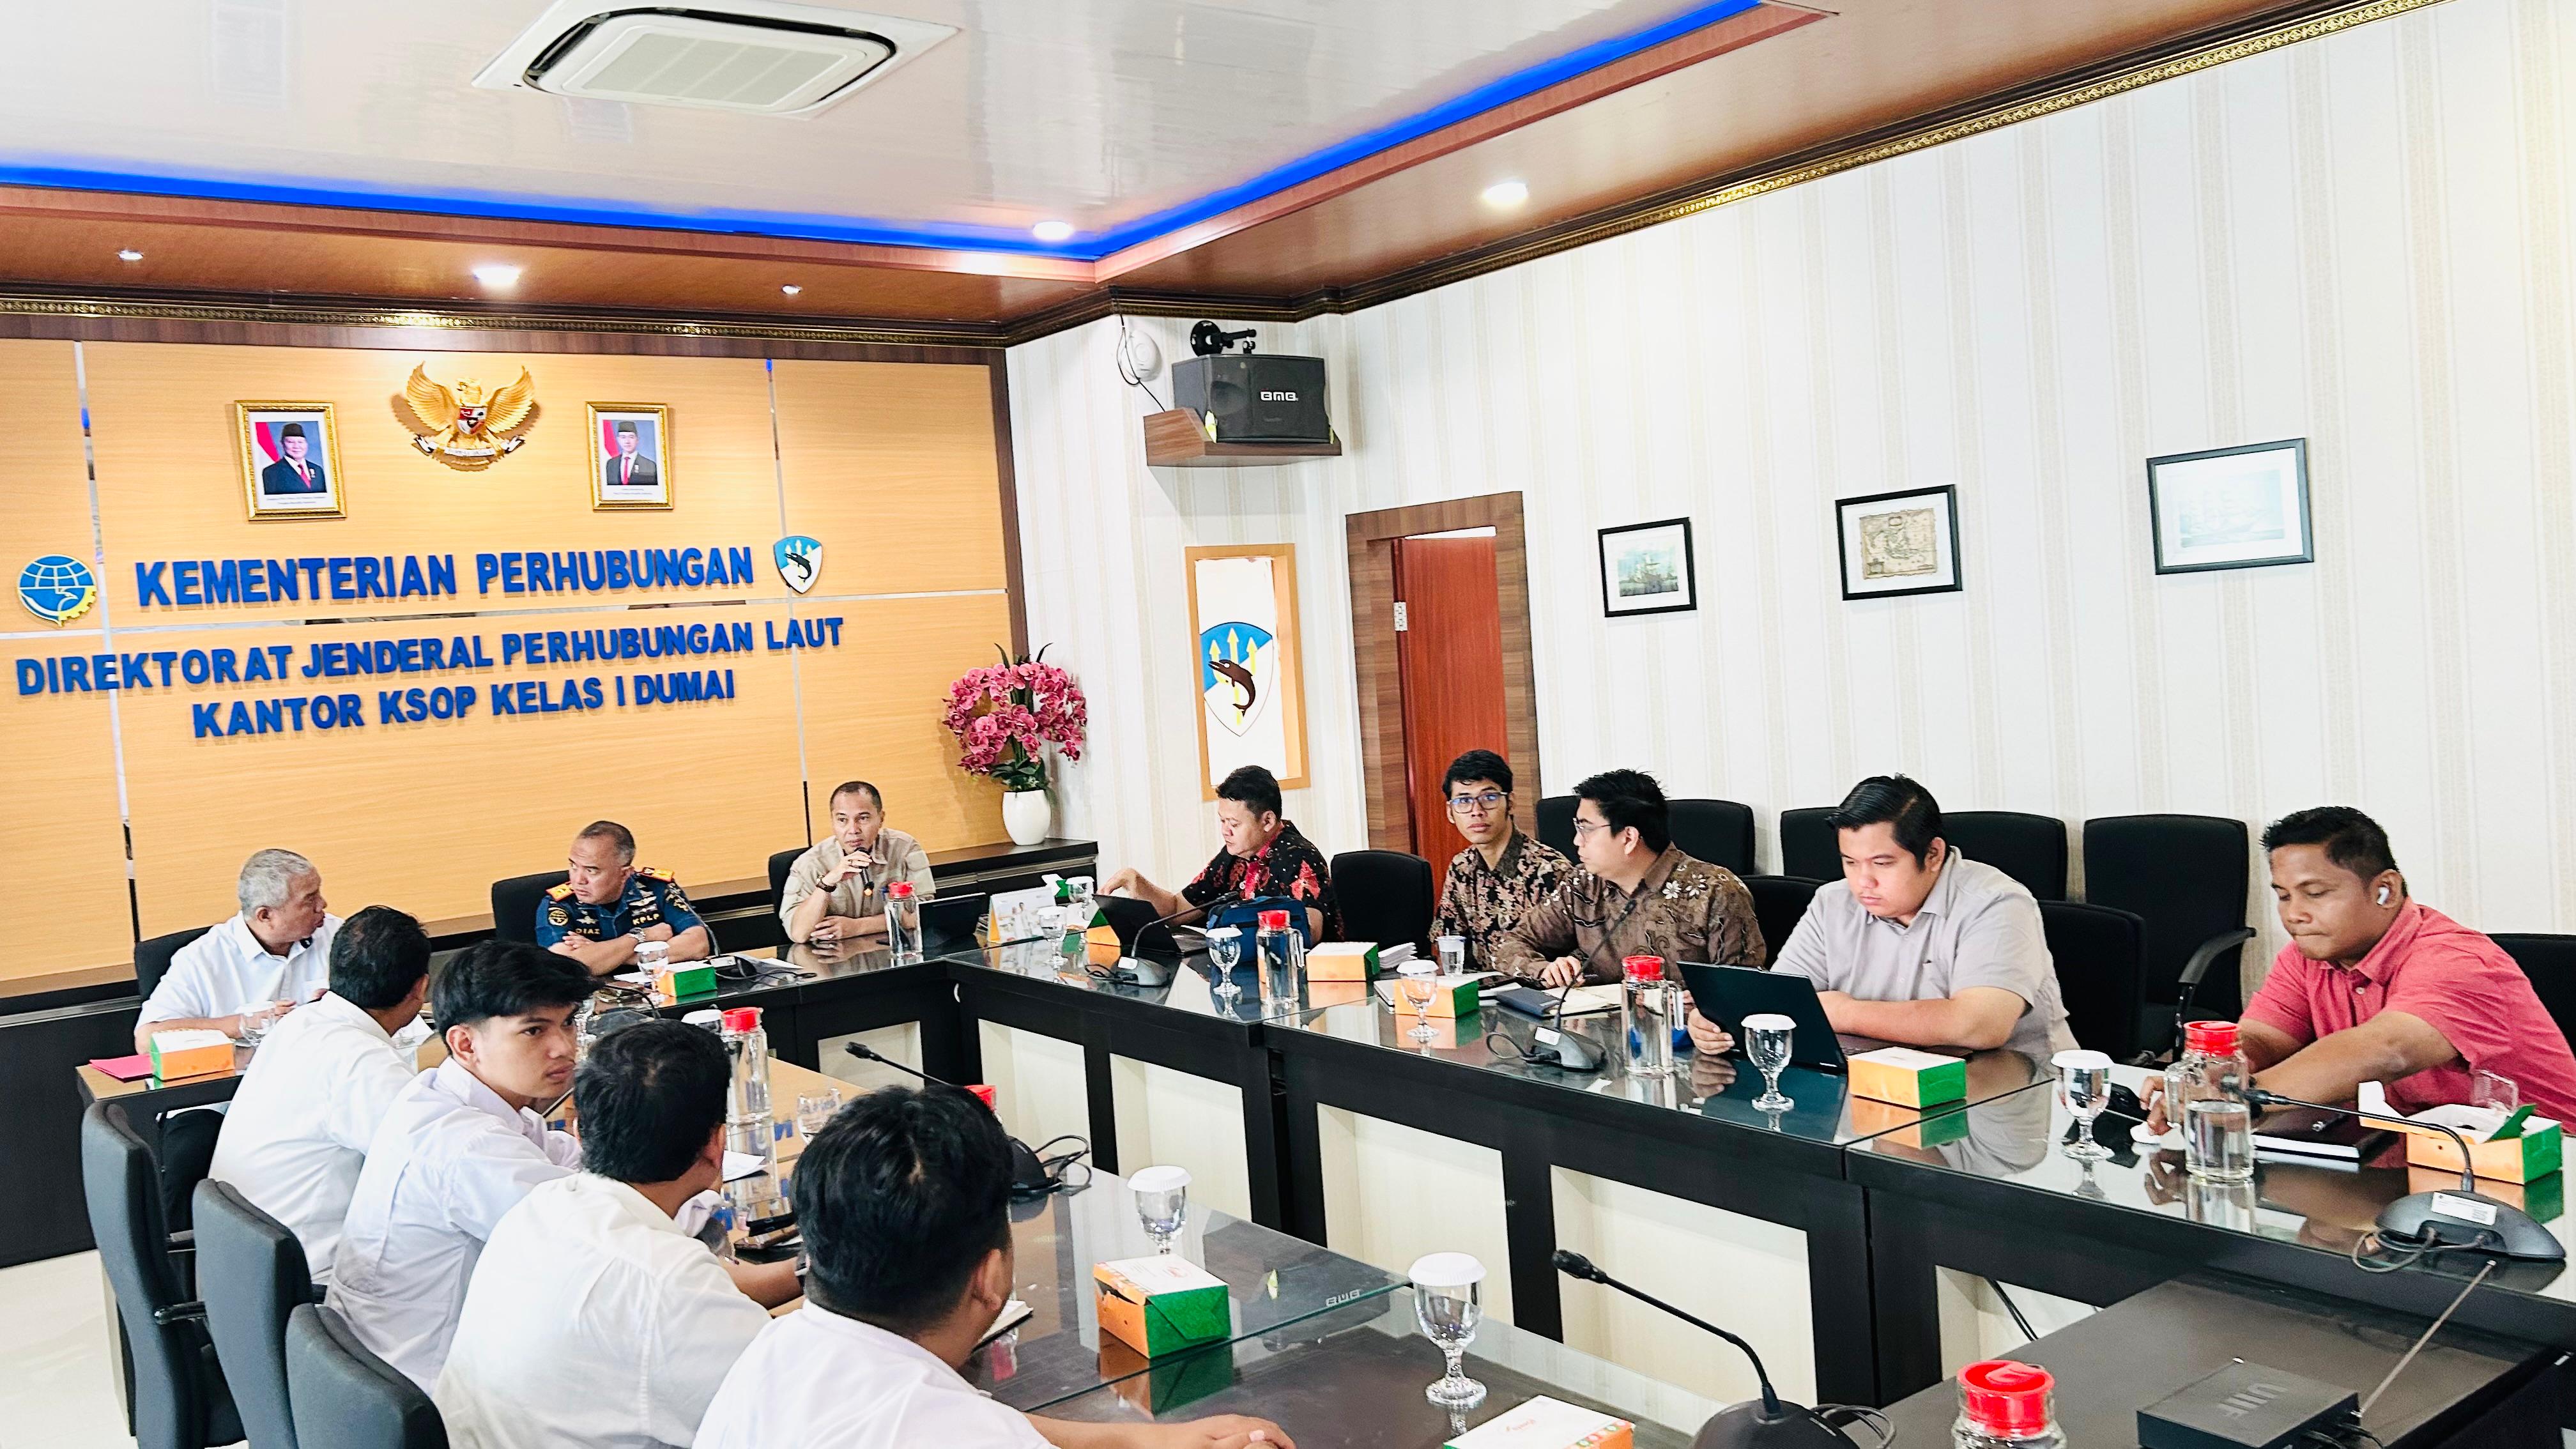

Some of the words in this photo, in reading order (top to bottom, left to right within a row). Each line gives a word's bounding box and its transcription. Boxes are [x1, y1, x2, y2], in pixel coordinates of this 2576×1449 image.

[135, 555, 457, 607] KEMENTERIAN
[476, 546, 755, 594] PERHUBUNGAN
[16, 645, 293, 696] DIREKTORAT
[302, 635, 493, 678] JENDERAL
[502, 622, 754, 666] PERHUBUNGAN
[765, 617, 843, 650] LAUT
[193, 694, 364, 739] KANTOR
[379, 686, 477, 724] KSOP
[491, 677, 604, 716] KELAS
[615, 675, 625, 707] I
[634, 668, 735, 706] DUMAI
[632, 913, 660, 926] KPLP
